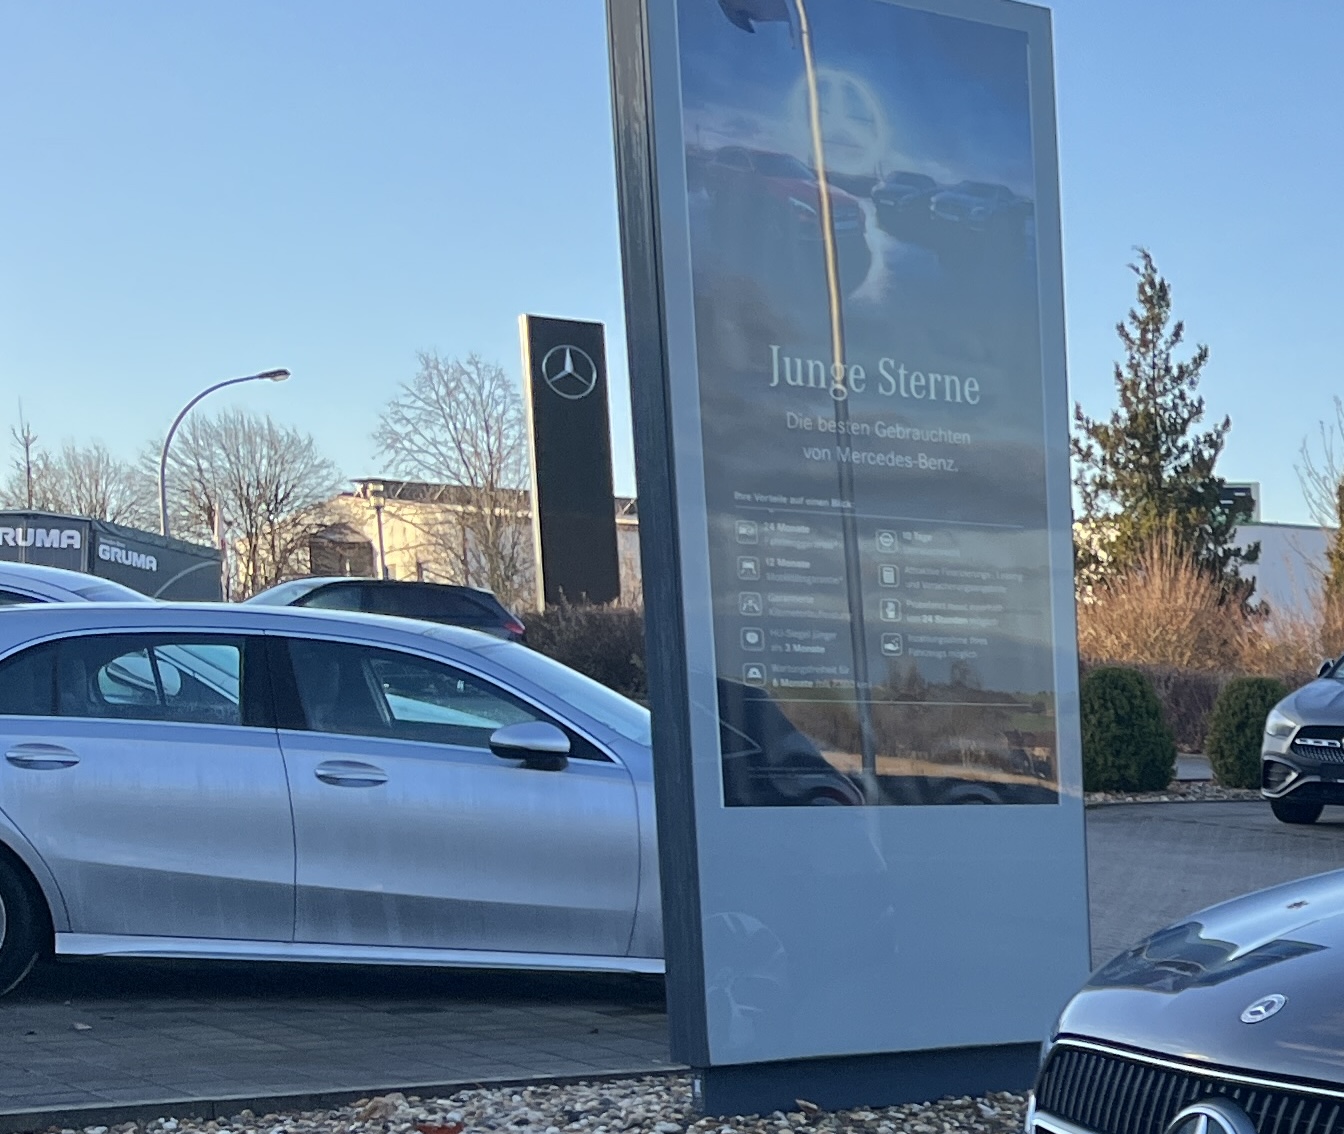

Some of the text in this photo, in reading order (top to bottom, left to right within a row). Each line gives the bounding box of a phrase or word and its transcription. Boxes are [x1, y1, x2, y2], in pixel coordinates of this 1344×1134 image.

[769, 344, 981, 405] Junge Sterne
[786, 412, 971, 445] Die besten Gebrauchten
[803, 446, 959, 472] von Mercedes-Benz.
[0, 526, 81, 549] RUMA
[98, 543, 158, 572] GRUMA
